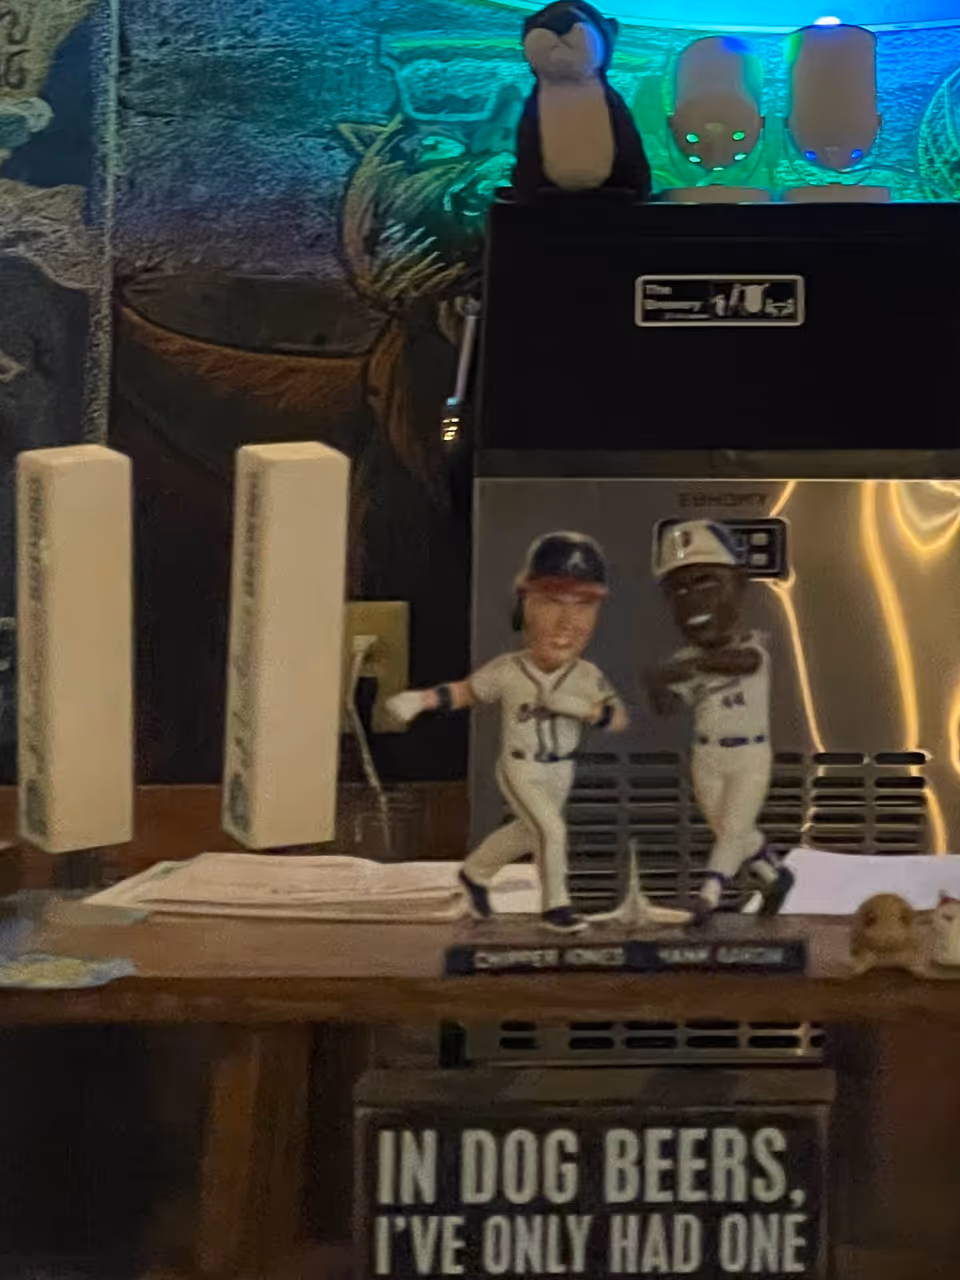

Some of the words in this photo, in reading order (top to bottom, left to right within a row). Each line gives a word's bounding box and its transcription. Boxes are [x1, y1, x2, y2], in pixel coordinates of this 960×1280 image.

[377, 1130, 437, 1205] IN
[460, 1129, 578, 1204] DOG
[604, 1128, 806, 1208] BEERS,
[375, 1215, 466, 1274] I'VE
[483, 1214, 593, 1274] ONLY
[609, 1214, 700, 1273] HAD
[718, 1213, 807, 1272] ONE
